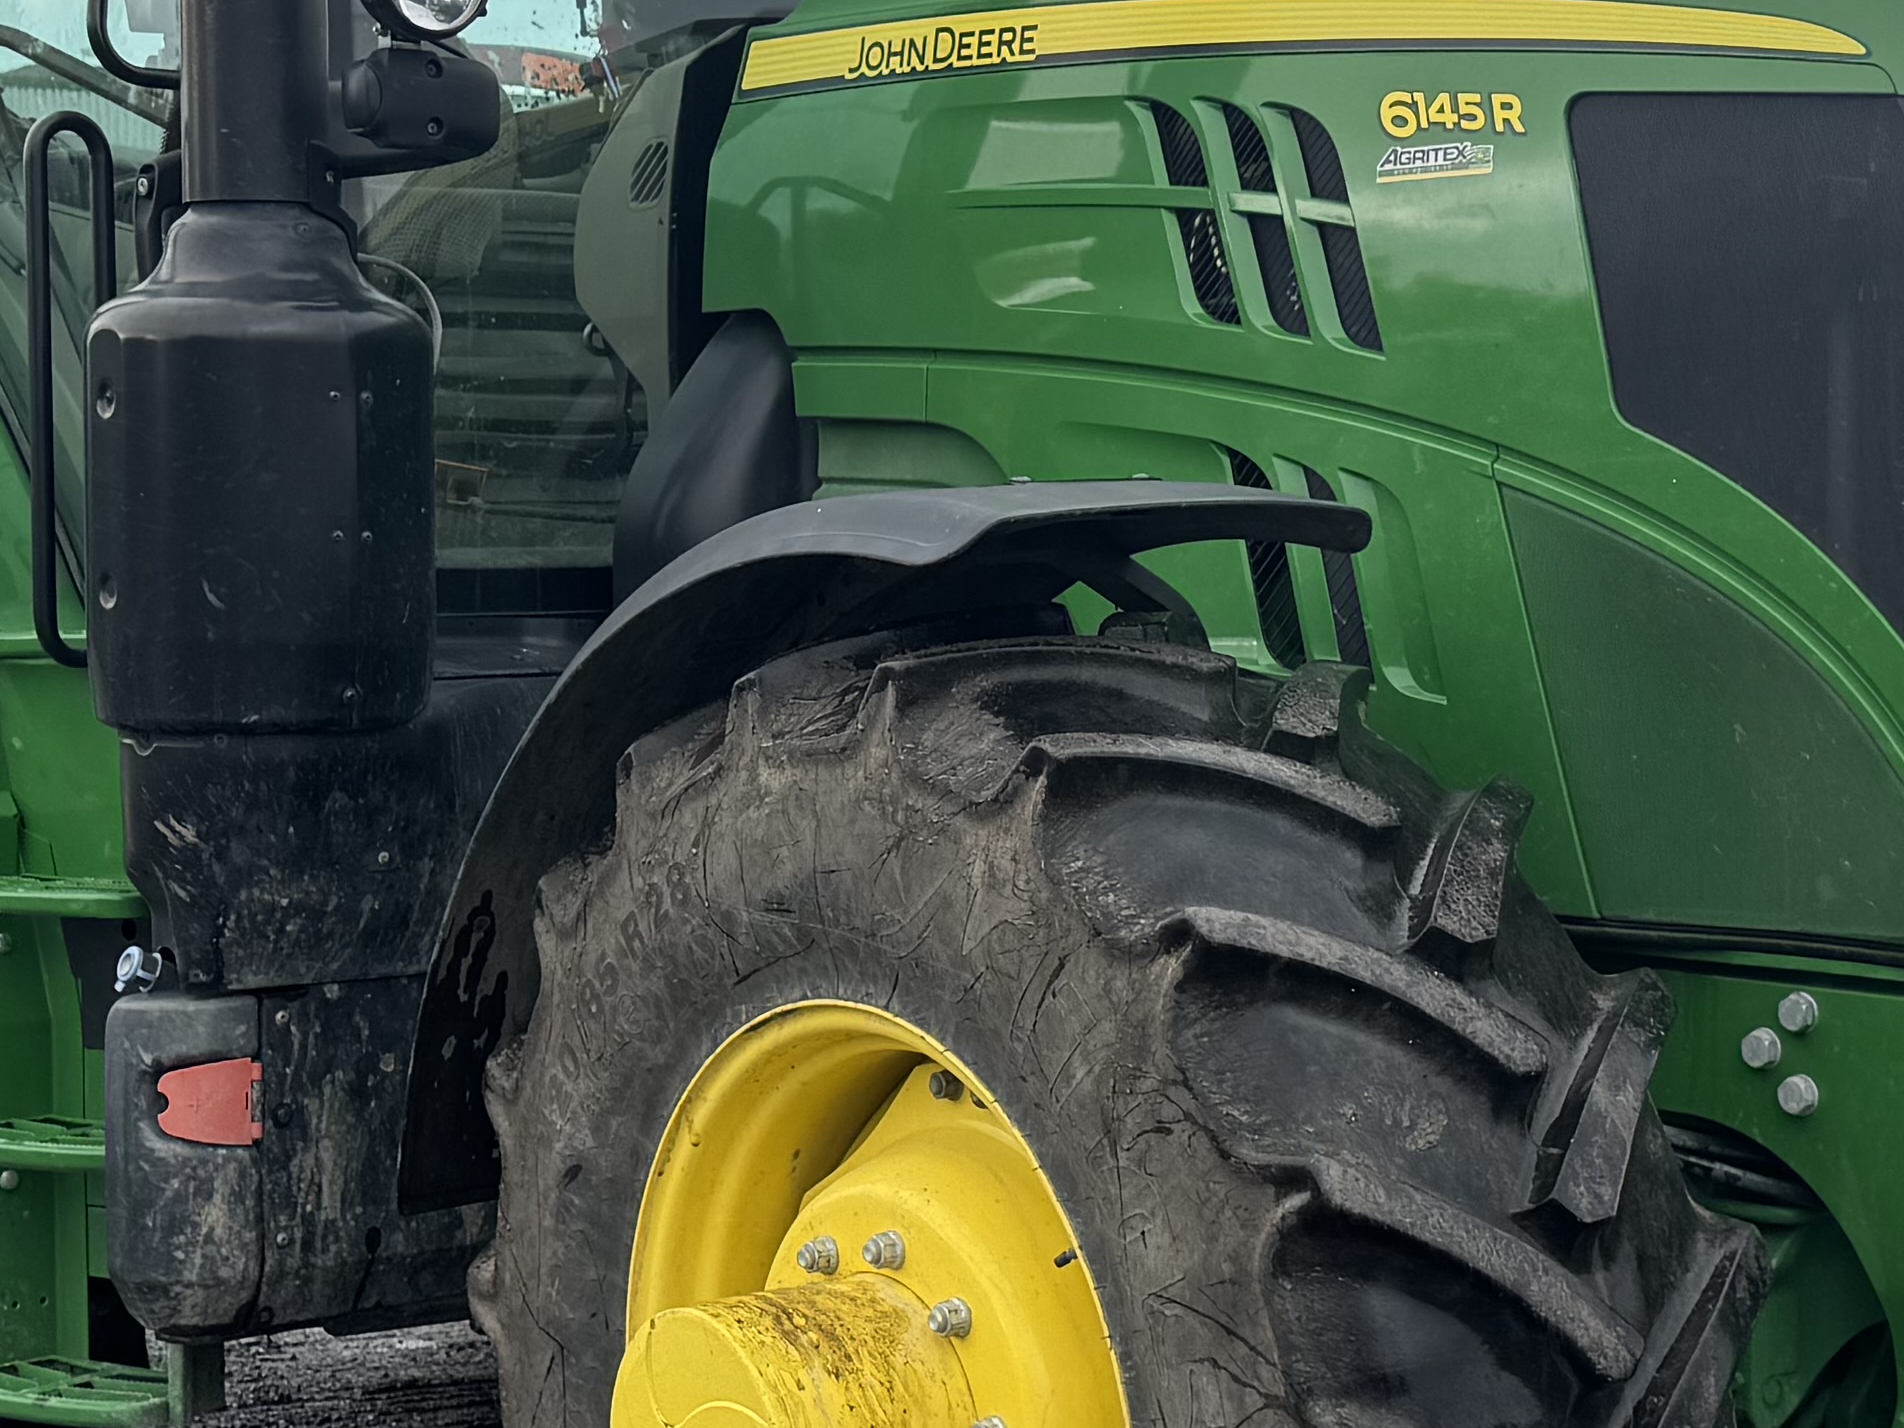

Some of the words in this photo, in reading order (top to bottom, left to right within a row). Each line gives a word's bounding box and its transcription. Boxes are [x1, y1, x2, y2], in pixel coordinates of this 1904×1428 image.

[848, 35, 928, 74] JOHN
[932, 24, 1039, 65] DEERE
[1380, 144, 1467, 168] AGRITEX
